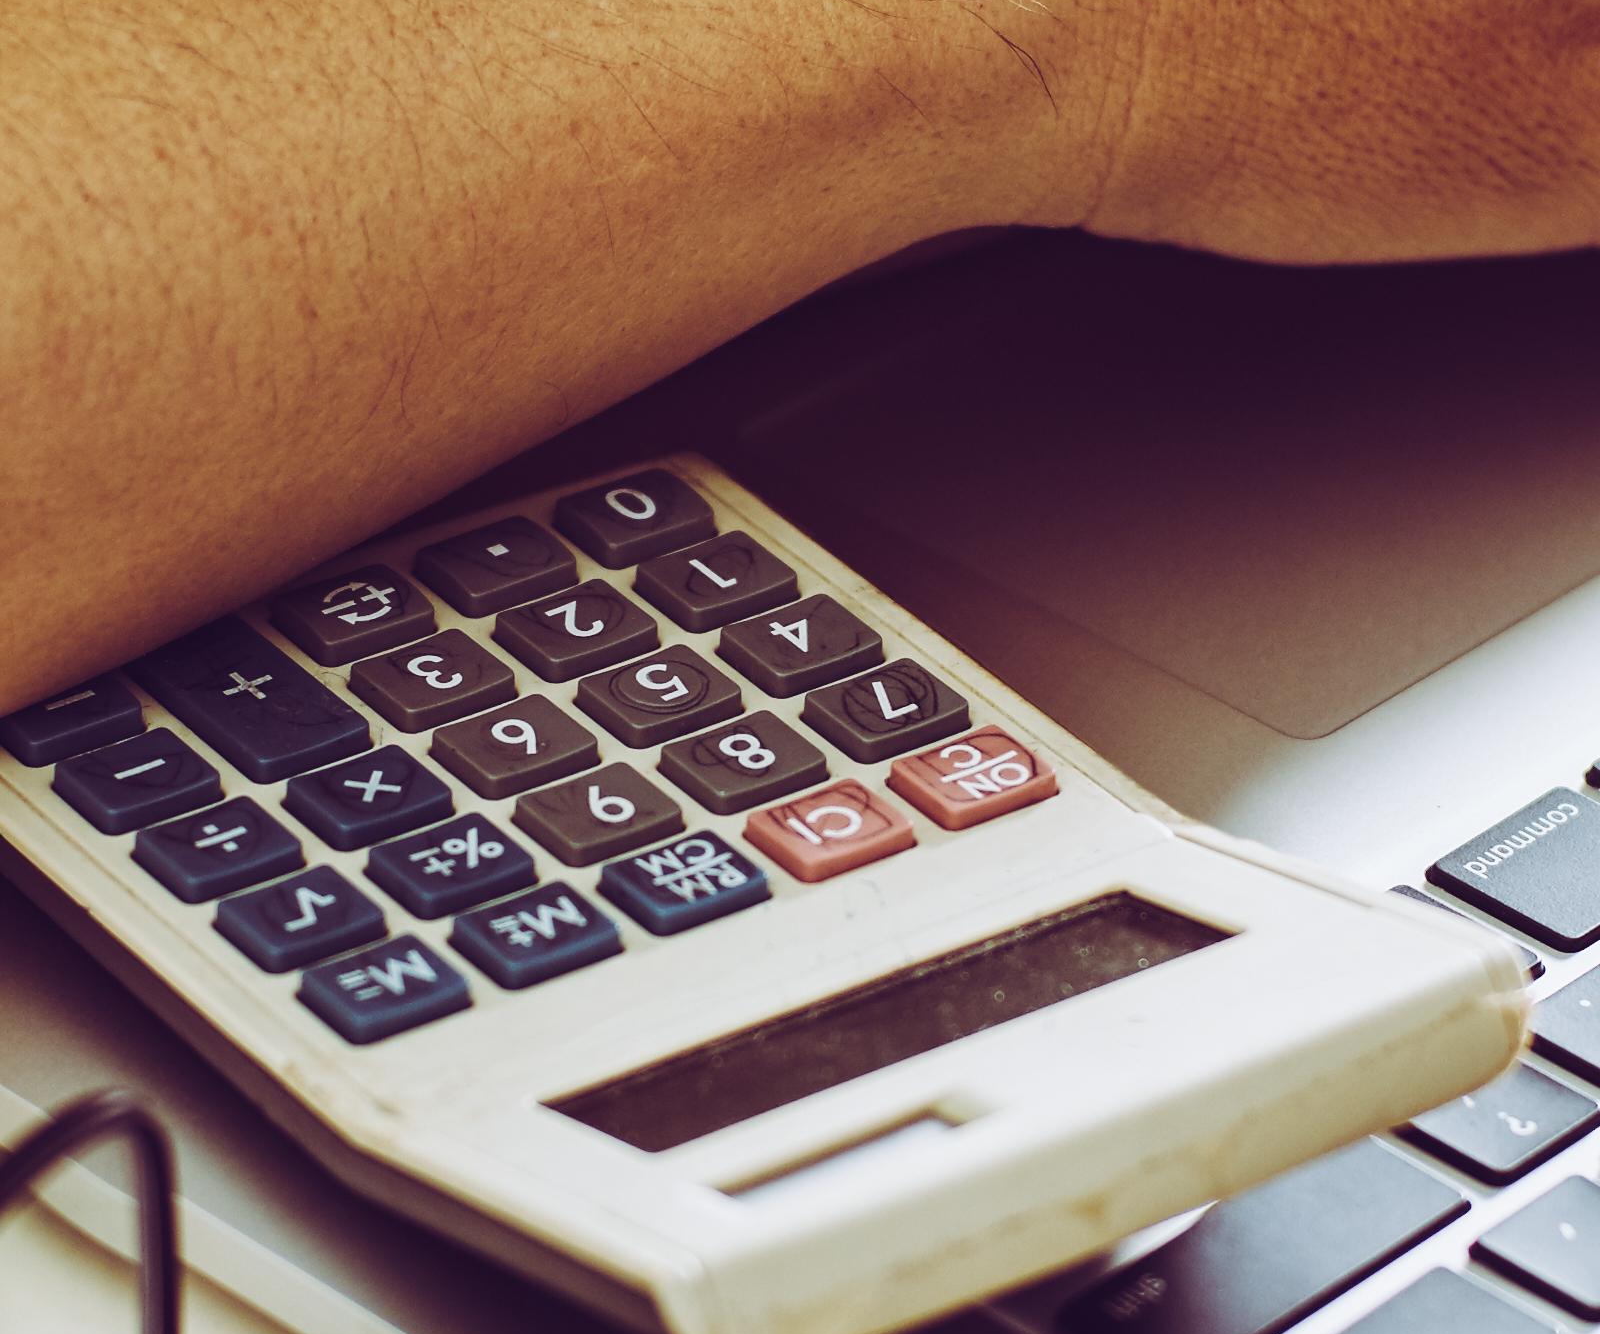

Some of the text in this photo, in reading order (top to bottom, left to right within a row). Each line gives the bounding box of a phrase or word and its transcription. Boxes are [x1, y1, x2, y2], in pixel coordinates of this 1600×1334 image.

[605, 488, 656, 520] 0
[689, 558, 737, 589] 1
[545, 601, 604, 637] 2
[769, 618, 809, 653] 4
[407, 654, 463, 689] 3
[636, 663, 689, 700] 5
[872, 681, 918, 719] 7
[491, 718, 537, 755] 6
[718, 733, 776, 770] 8
[588, 785, 635, 824] 9
[1463, 803, 1579, 879] command
